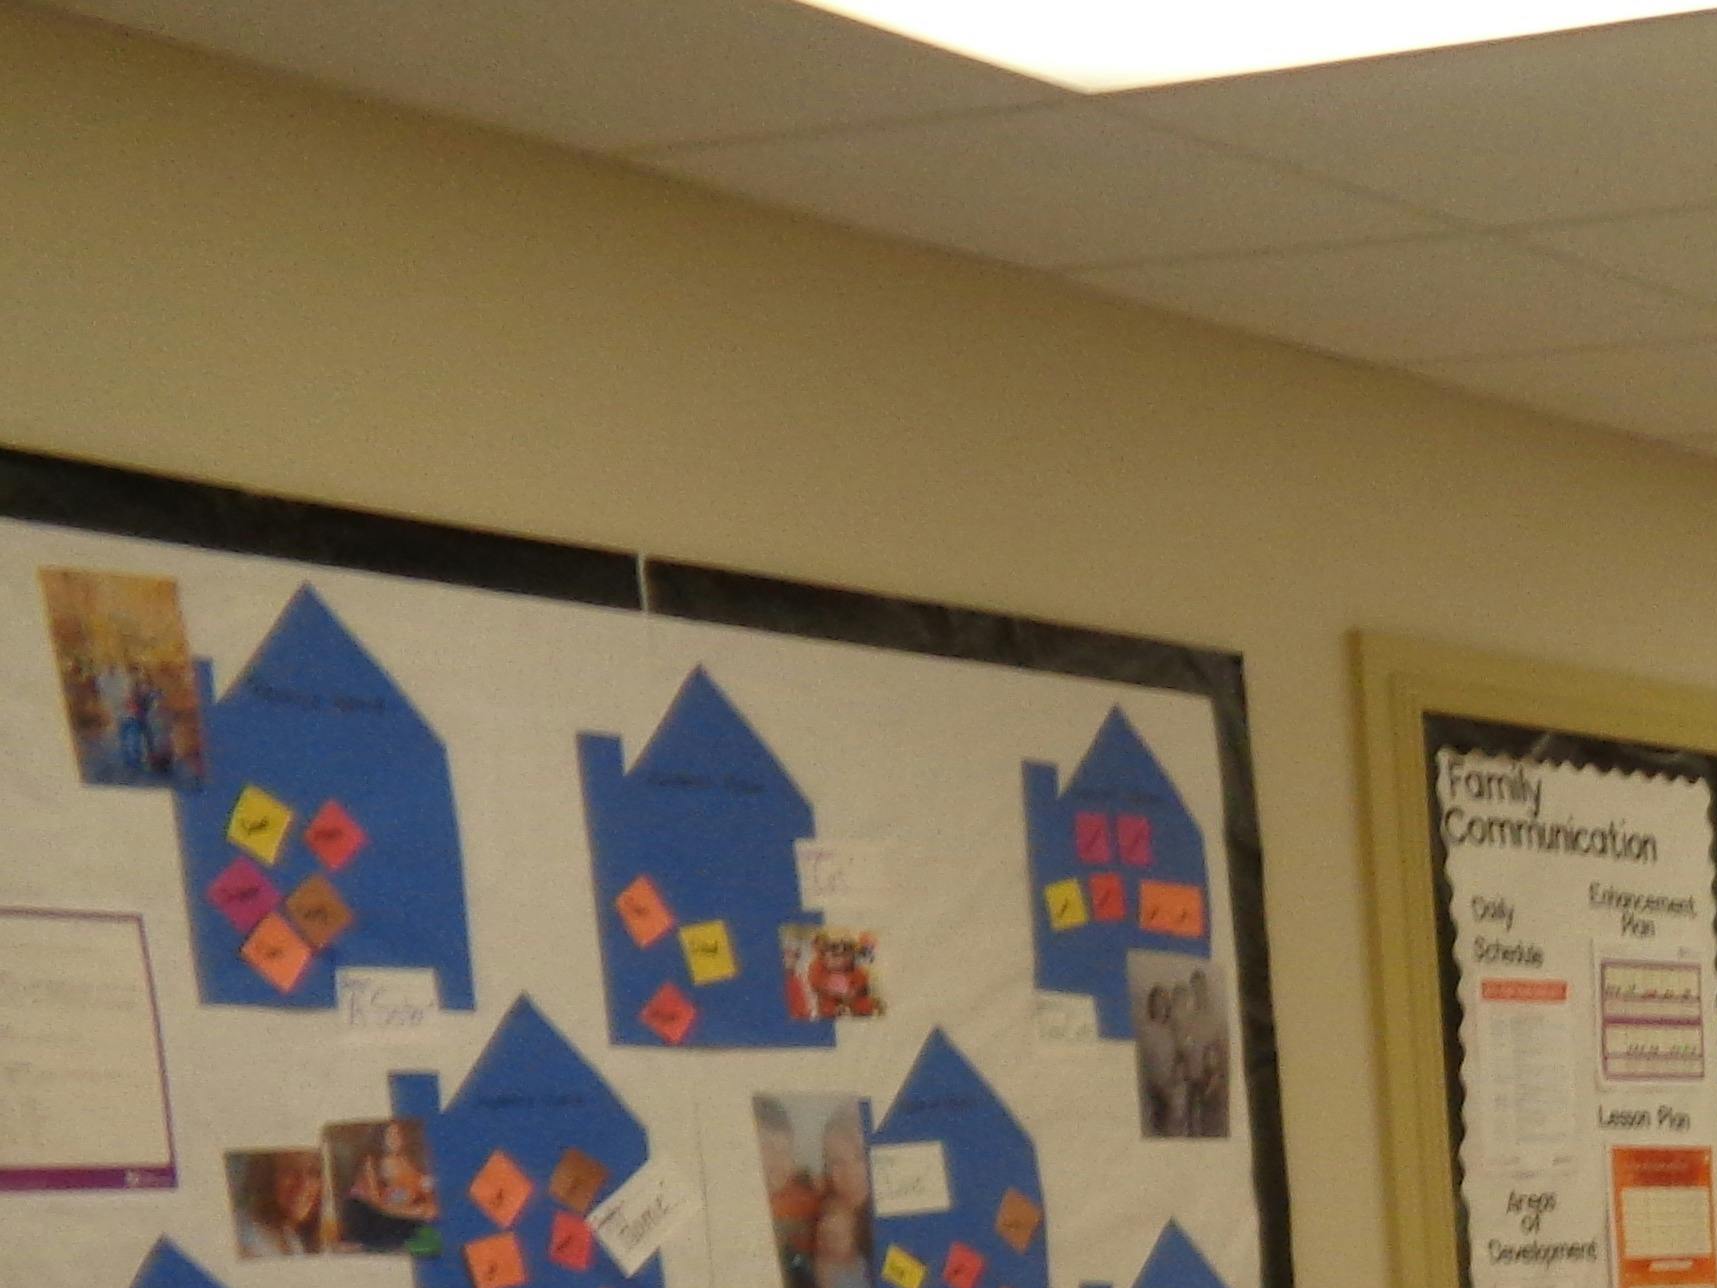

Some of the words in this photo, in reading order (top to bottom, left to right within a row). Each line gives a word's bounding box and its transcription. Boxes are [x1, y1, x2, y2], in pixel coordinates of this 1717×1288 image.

[1446, 761, 1542, 815] Family
[1443, 809, 1658, 863] Communication
[1600, 1105, 1651, 1129] Lesson
[1657, 1106, 1691, 1132] Plan
[1506, 1189, 1557, 1215] Areas
[1488, 1238, 1598, 1270] Development
